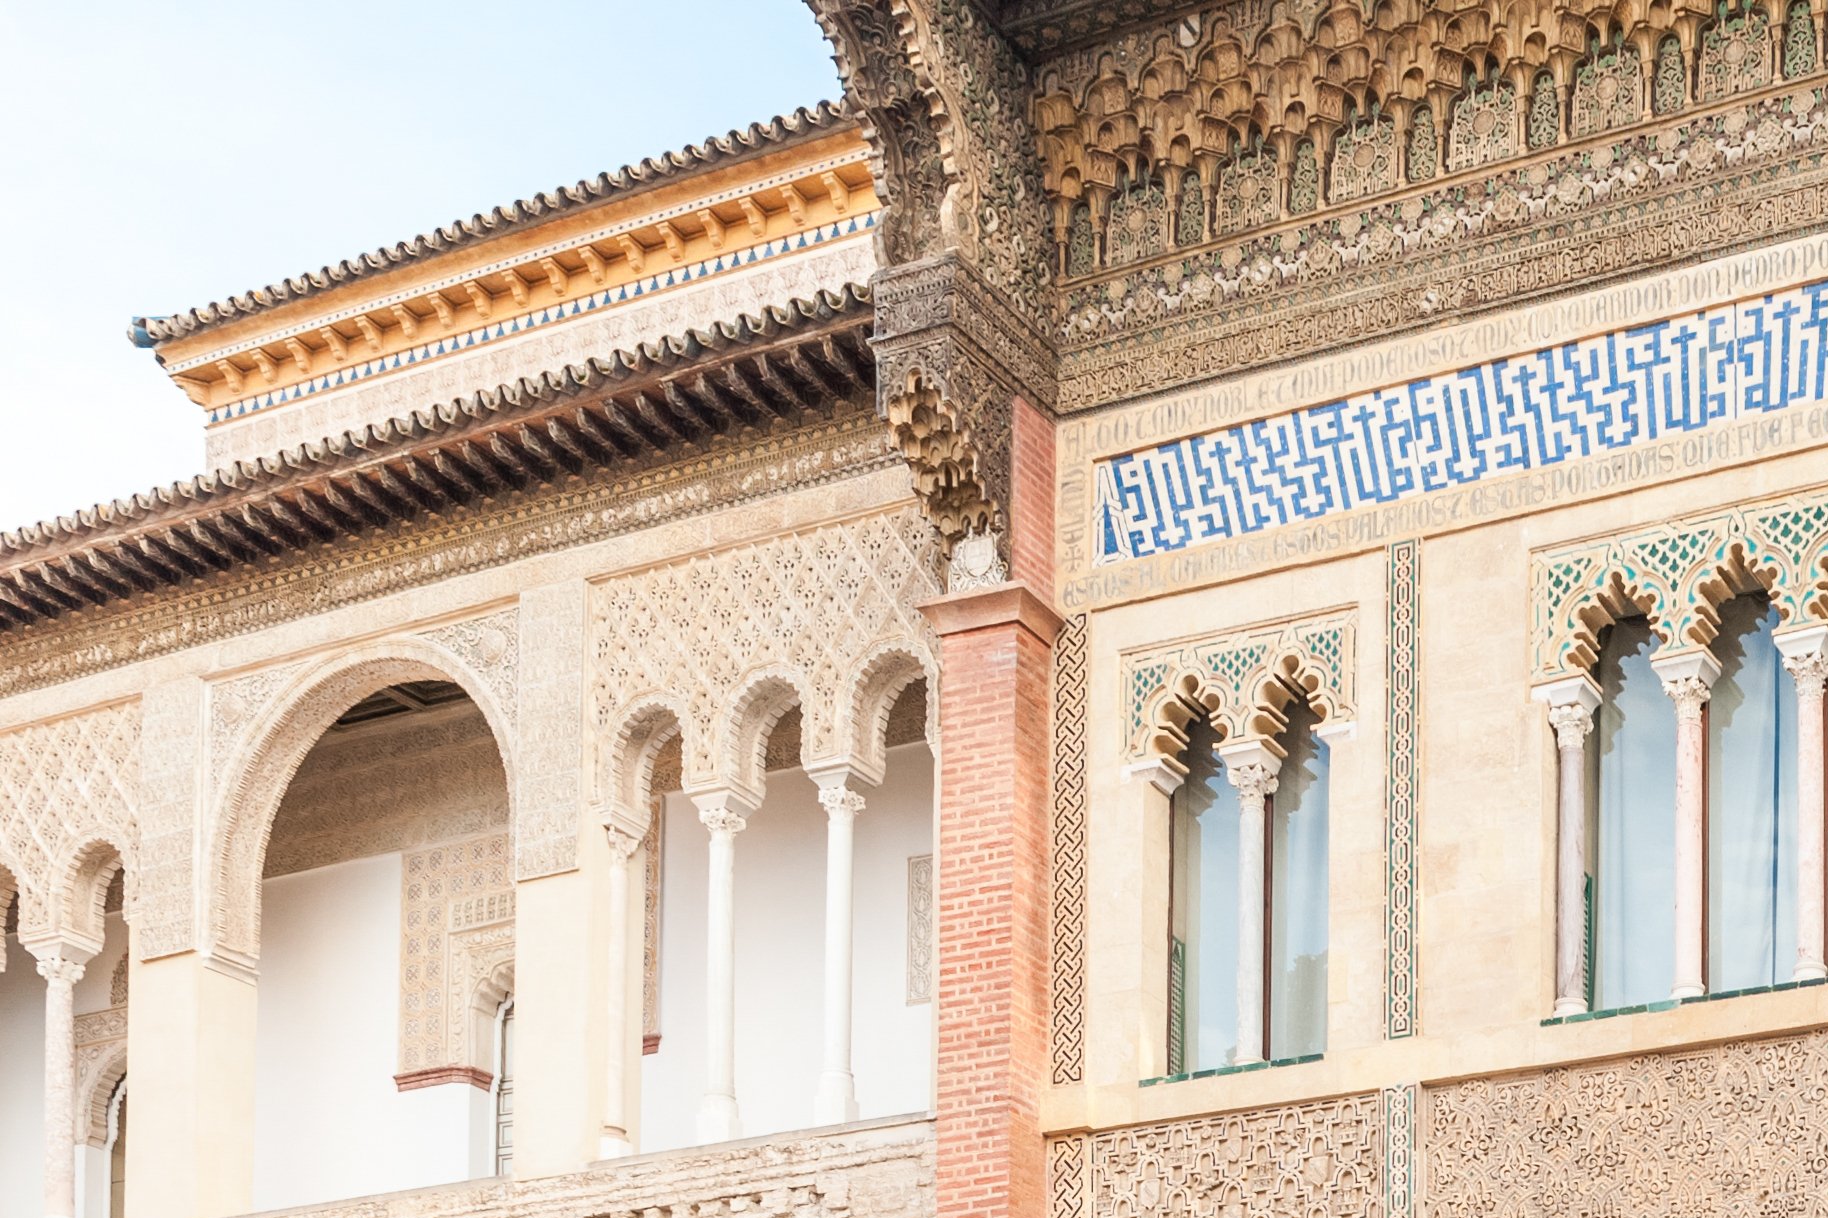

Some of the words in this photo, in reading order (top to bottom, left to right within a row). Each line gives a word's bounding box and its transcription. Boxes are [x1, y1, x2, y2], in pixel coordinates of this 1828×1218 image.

[1201, 381, 1269, 421] NOBLE
[1341, 334, 1455, 389] PODEROSO
[1678, 267, 1721, 304] DON
[1726, 248, 1797, 293] PEDRO
